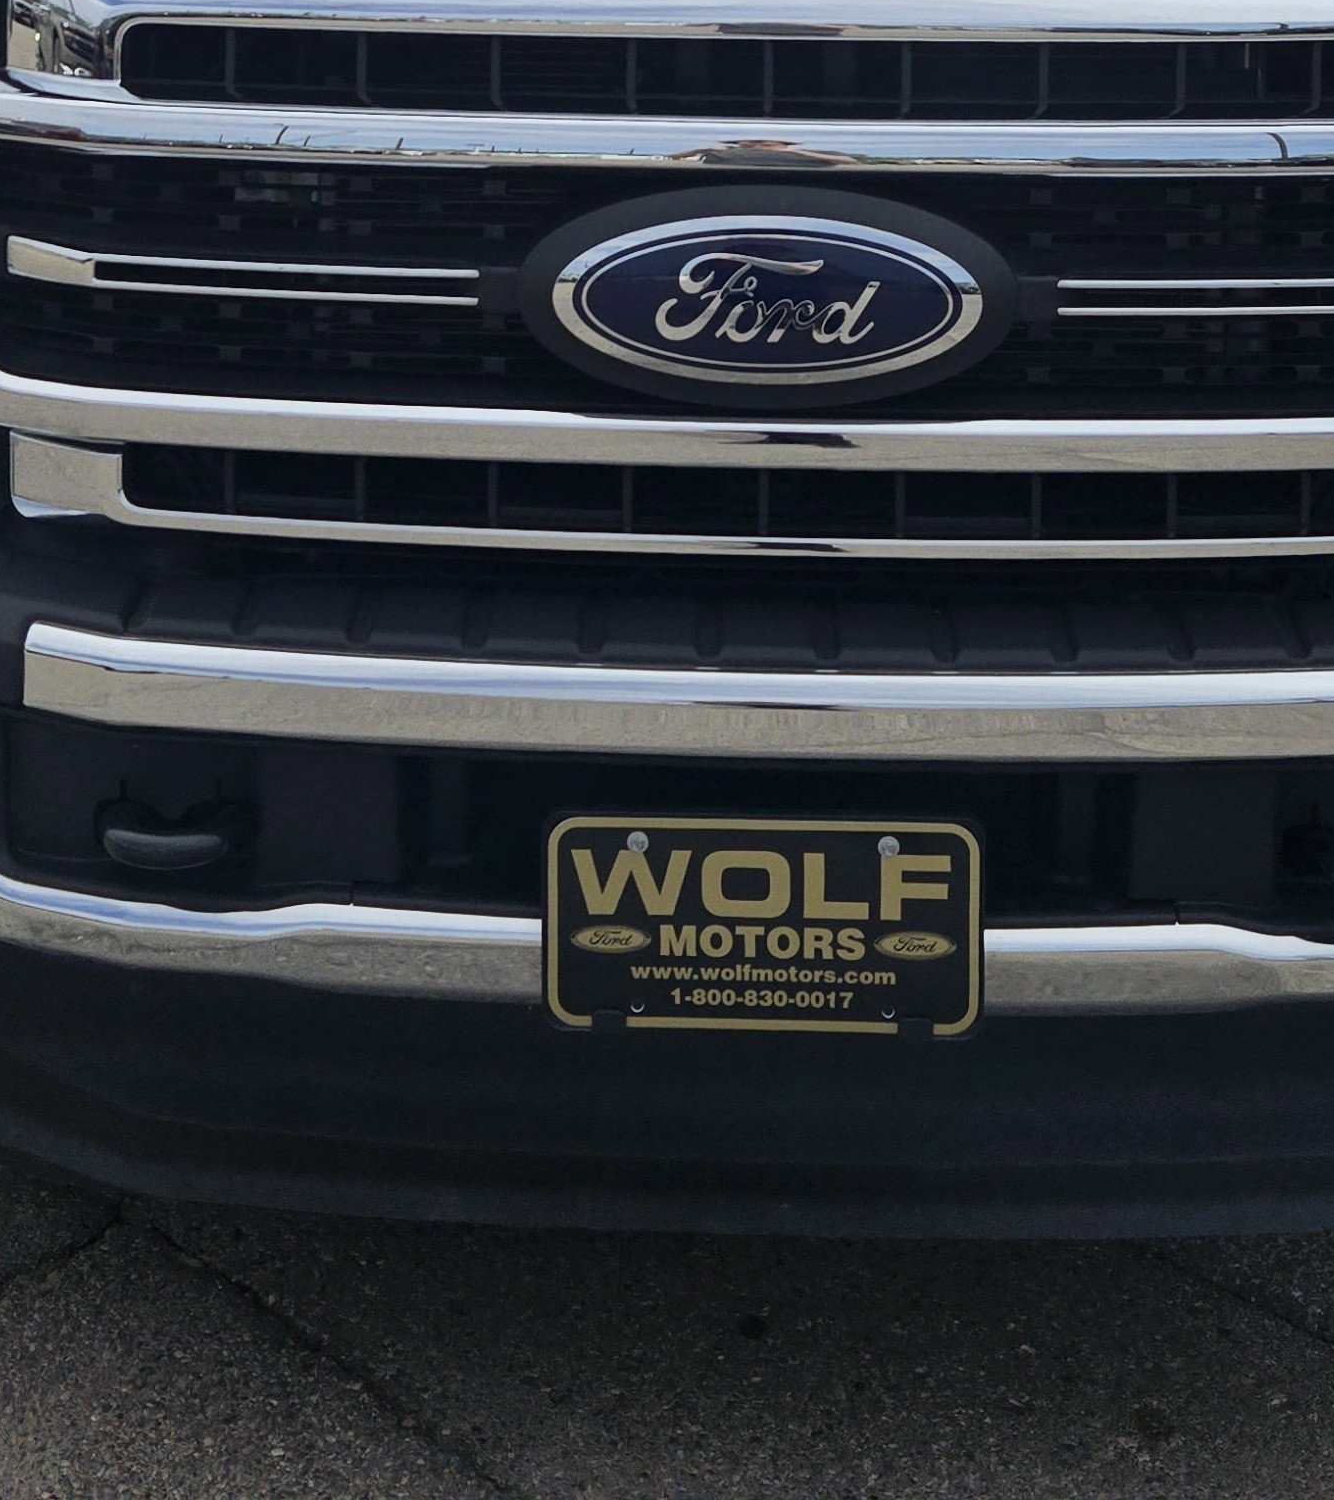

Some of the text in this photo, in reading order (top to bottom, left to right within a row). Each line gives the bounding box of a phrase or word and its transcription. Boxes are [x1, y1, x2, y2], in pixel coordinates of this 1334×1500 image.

[654, 251, 881, 345] Ford
[570, 848, 952, 921] WOLF
[588, 929, 633, 947] Ford
[659, 924, 866, 962] MOTORS
[893, 936, 938, 954] Ford
[630, 963, 897, 986] www.wolfmotors.com
[670, 987, 855, 1010] 1-800-830-0017
